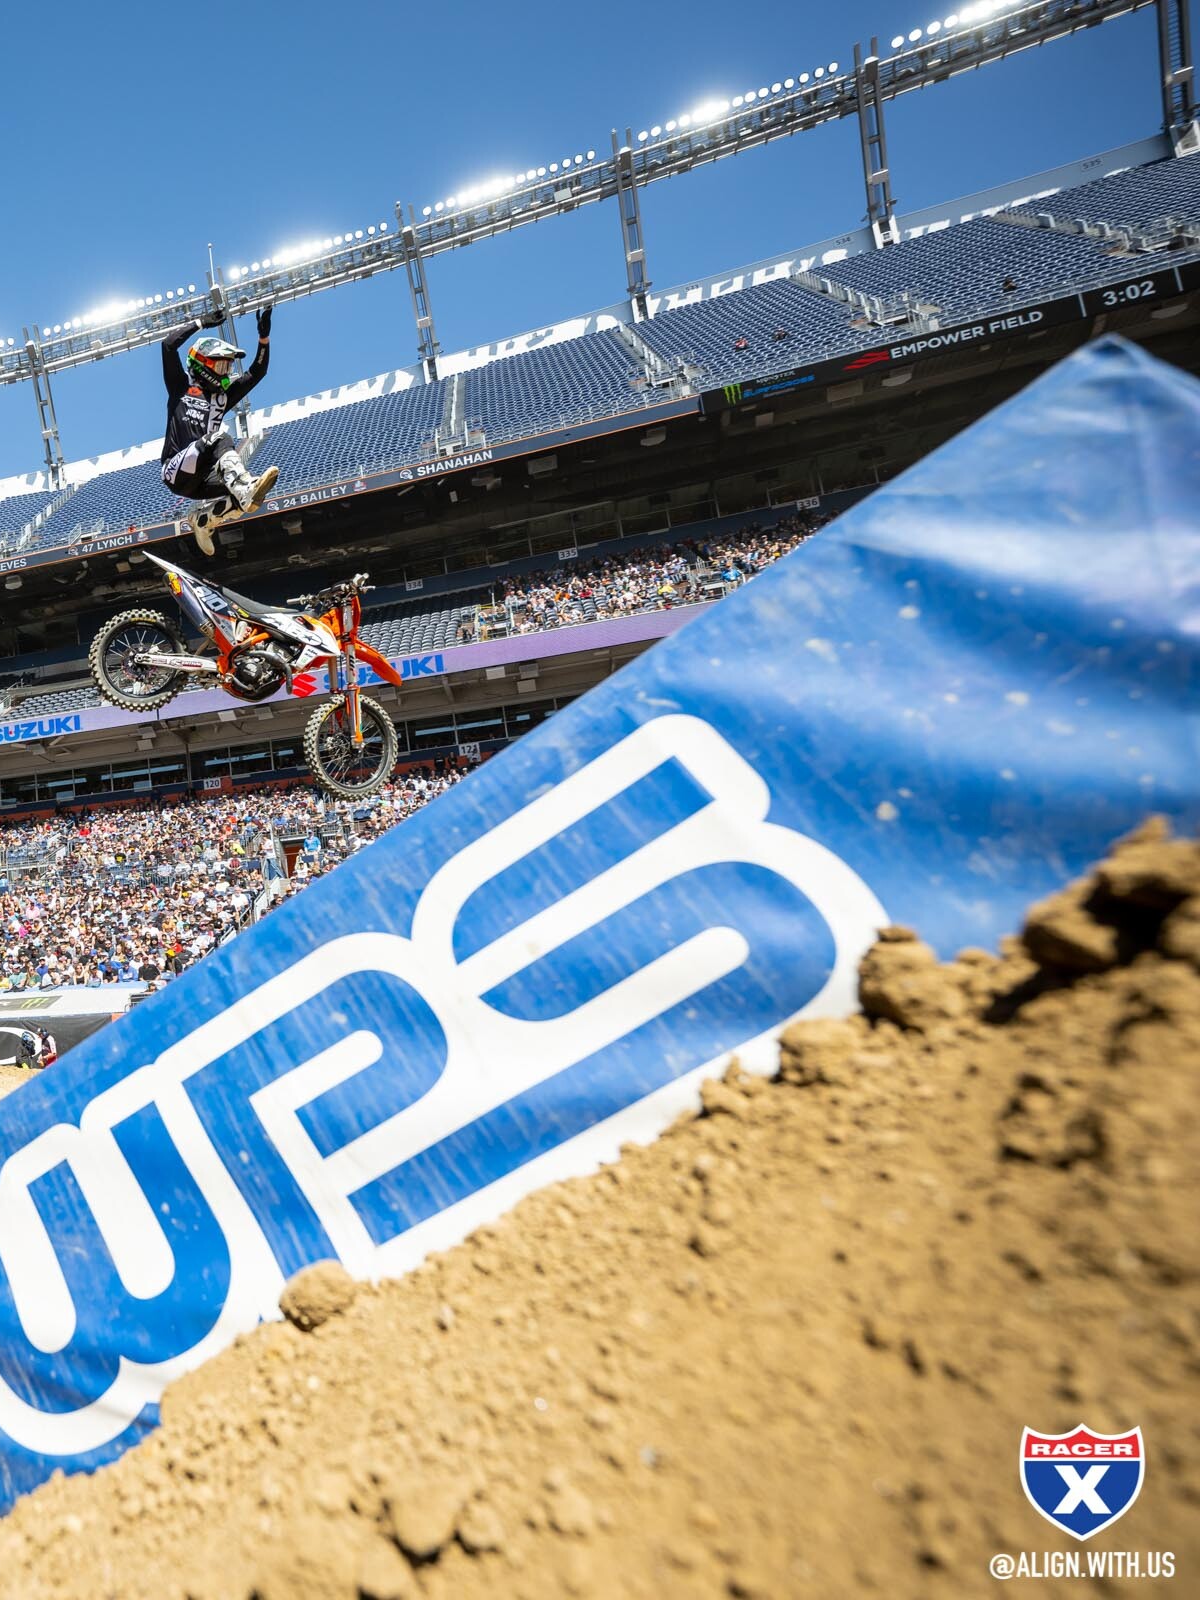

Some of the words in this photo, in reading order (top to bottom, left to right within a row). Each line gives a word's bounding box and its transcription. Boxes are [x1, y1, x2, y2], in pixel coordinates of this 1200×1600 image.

[1103, 280, 1156, 306] 3:02
[890, 326, 984, 360] EMPOWER
[989, 310, 1043, 334] FIELD
[417, 450, 493, 477] SHANAHAN
[283, 495, 297, 508] 24
[300, 485, 347, 505] BAILEY
[81, 543, 94, 553] 47
[97, 534, 133, 551] LYNCH
[206, 779, 219, 789] 120
